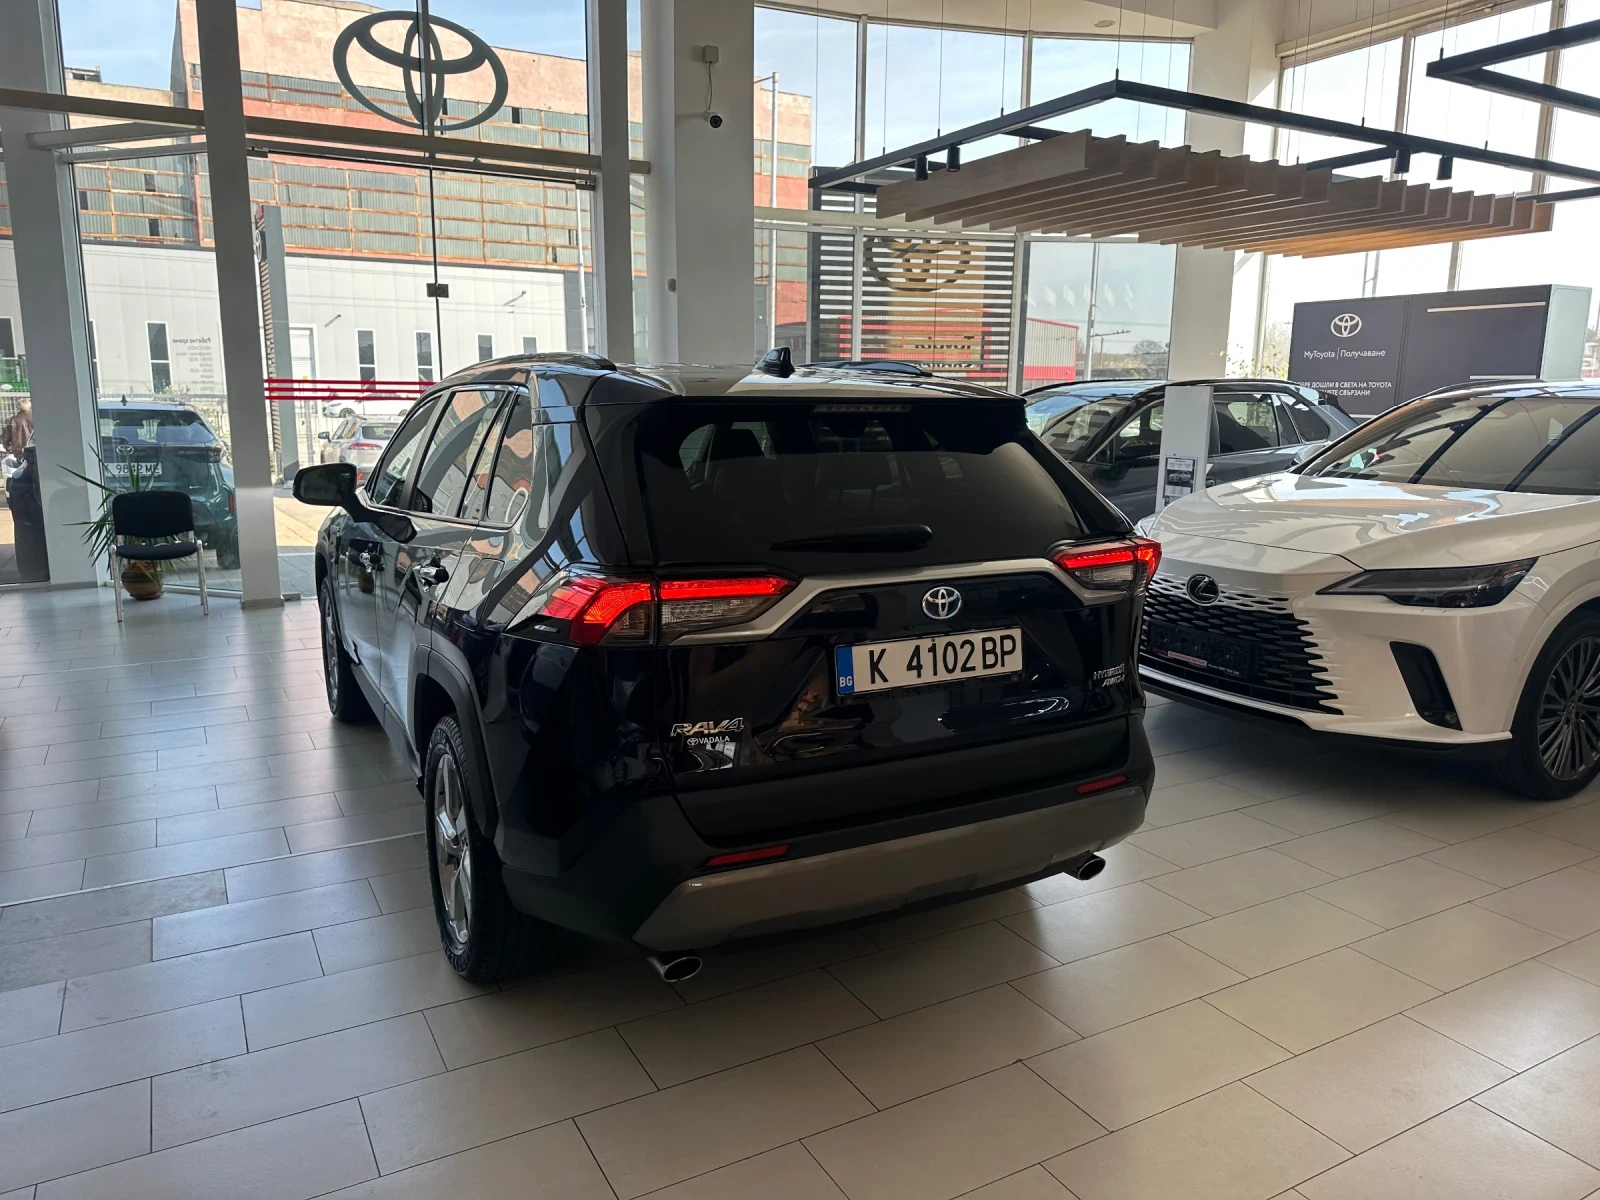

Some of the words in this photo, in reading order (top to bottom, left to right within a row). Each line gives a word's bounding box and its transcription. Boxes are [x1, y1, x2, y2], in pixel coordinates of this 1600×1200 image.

[1303, 350, 1335, 360] MyToyota
[1340, 349, 1386, 359] Получаване
[868, 648, 889, 685] K
[839, 676, 853, 688] BG
[670, 717, 745, 737] RAV4
[698, 735, 731, 745] VADALA
